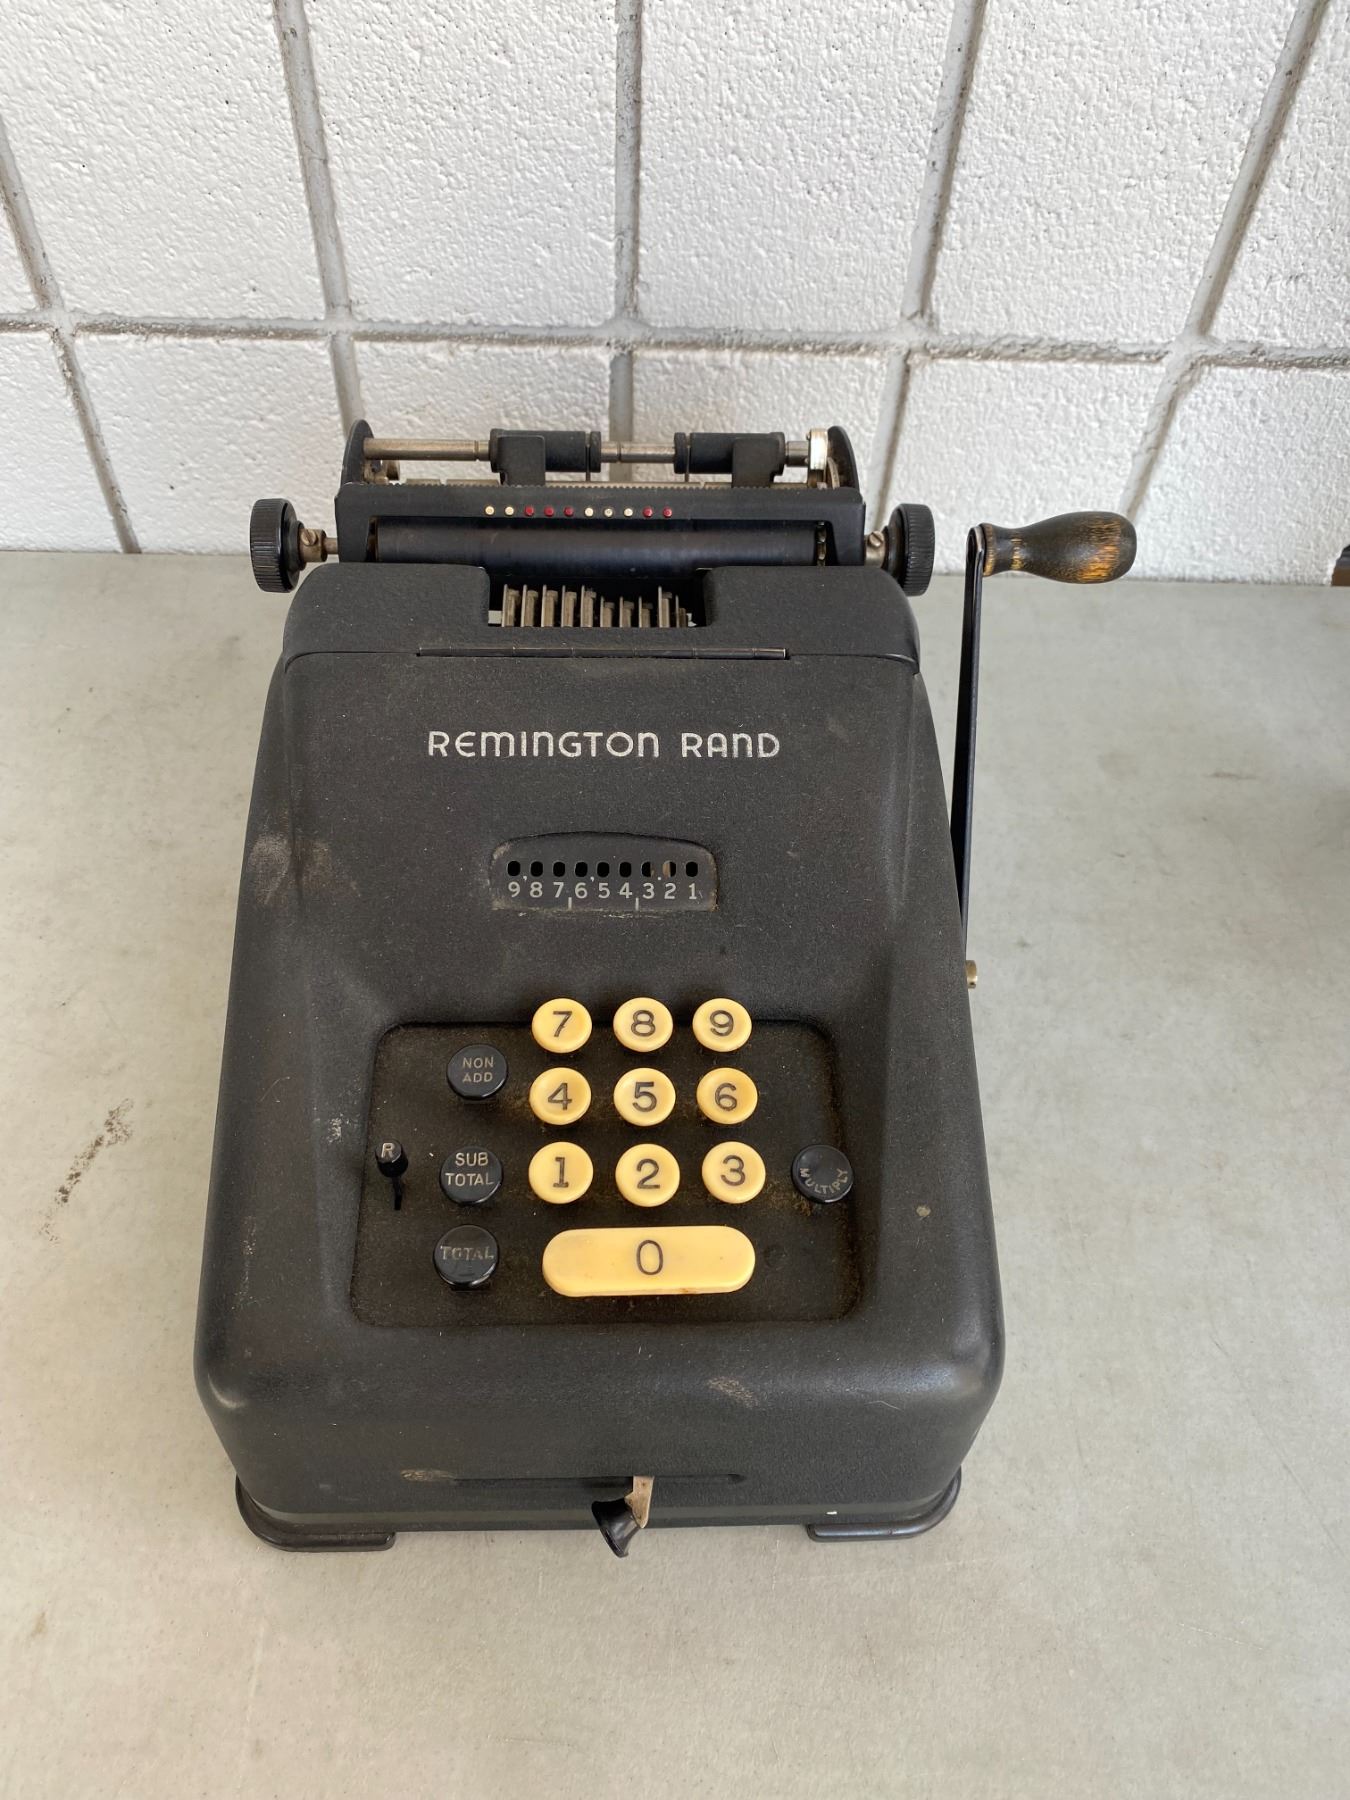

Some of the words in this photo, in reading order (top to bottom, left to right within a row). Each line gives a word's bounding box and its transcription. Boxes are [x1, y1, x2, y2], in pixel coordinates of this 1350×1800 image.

[428, 731, 660, 758] REMINGTON
[681, 732, 780, 758] RAND
[508, 881, 521, 898] 9
[529, 882, 543, 899] 8
[553, 881, 565, 899] 7
[574, 882, 588, 899] 6
[598, 882, 611, 899] 5
[619, 882, 633, 899] 4
[642, 883, 655, 899] 3
[664, 883, 677, 900] 2
[688, 883, 697, 900] 1
[552, 1010, 573, 1037] 7
[630, 1009, 656, 1037] 8
[709, 1009, 734, 1036] 9
[462, 1057, 494, 1069] NON
[462, 1072, 493, 1083] ADD
[547, 1082, 572, 1111] 4
[632, 1081, 658, 1112] 5
[714, 1082, 737, 1111] 6
[381, 1142, 396, 1158] R
[455, 1152, 488, 1167] SUB
[445, 1172, 494, 1187] TOTAL
[552, 1156, 569, 1188] 1
[636, 1158, 660, 1189] 2
[720, 1154, 746, 1186] 3
[440, 1245, 494, 1260] TOTAL
[636, 1239, 664, 1276] 0
